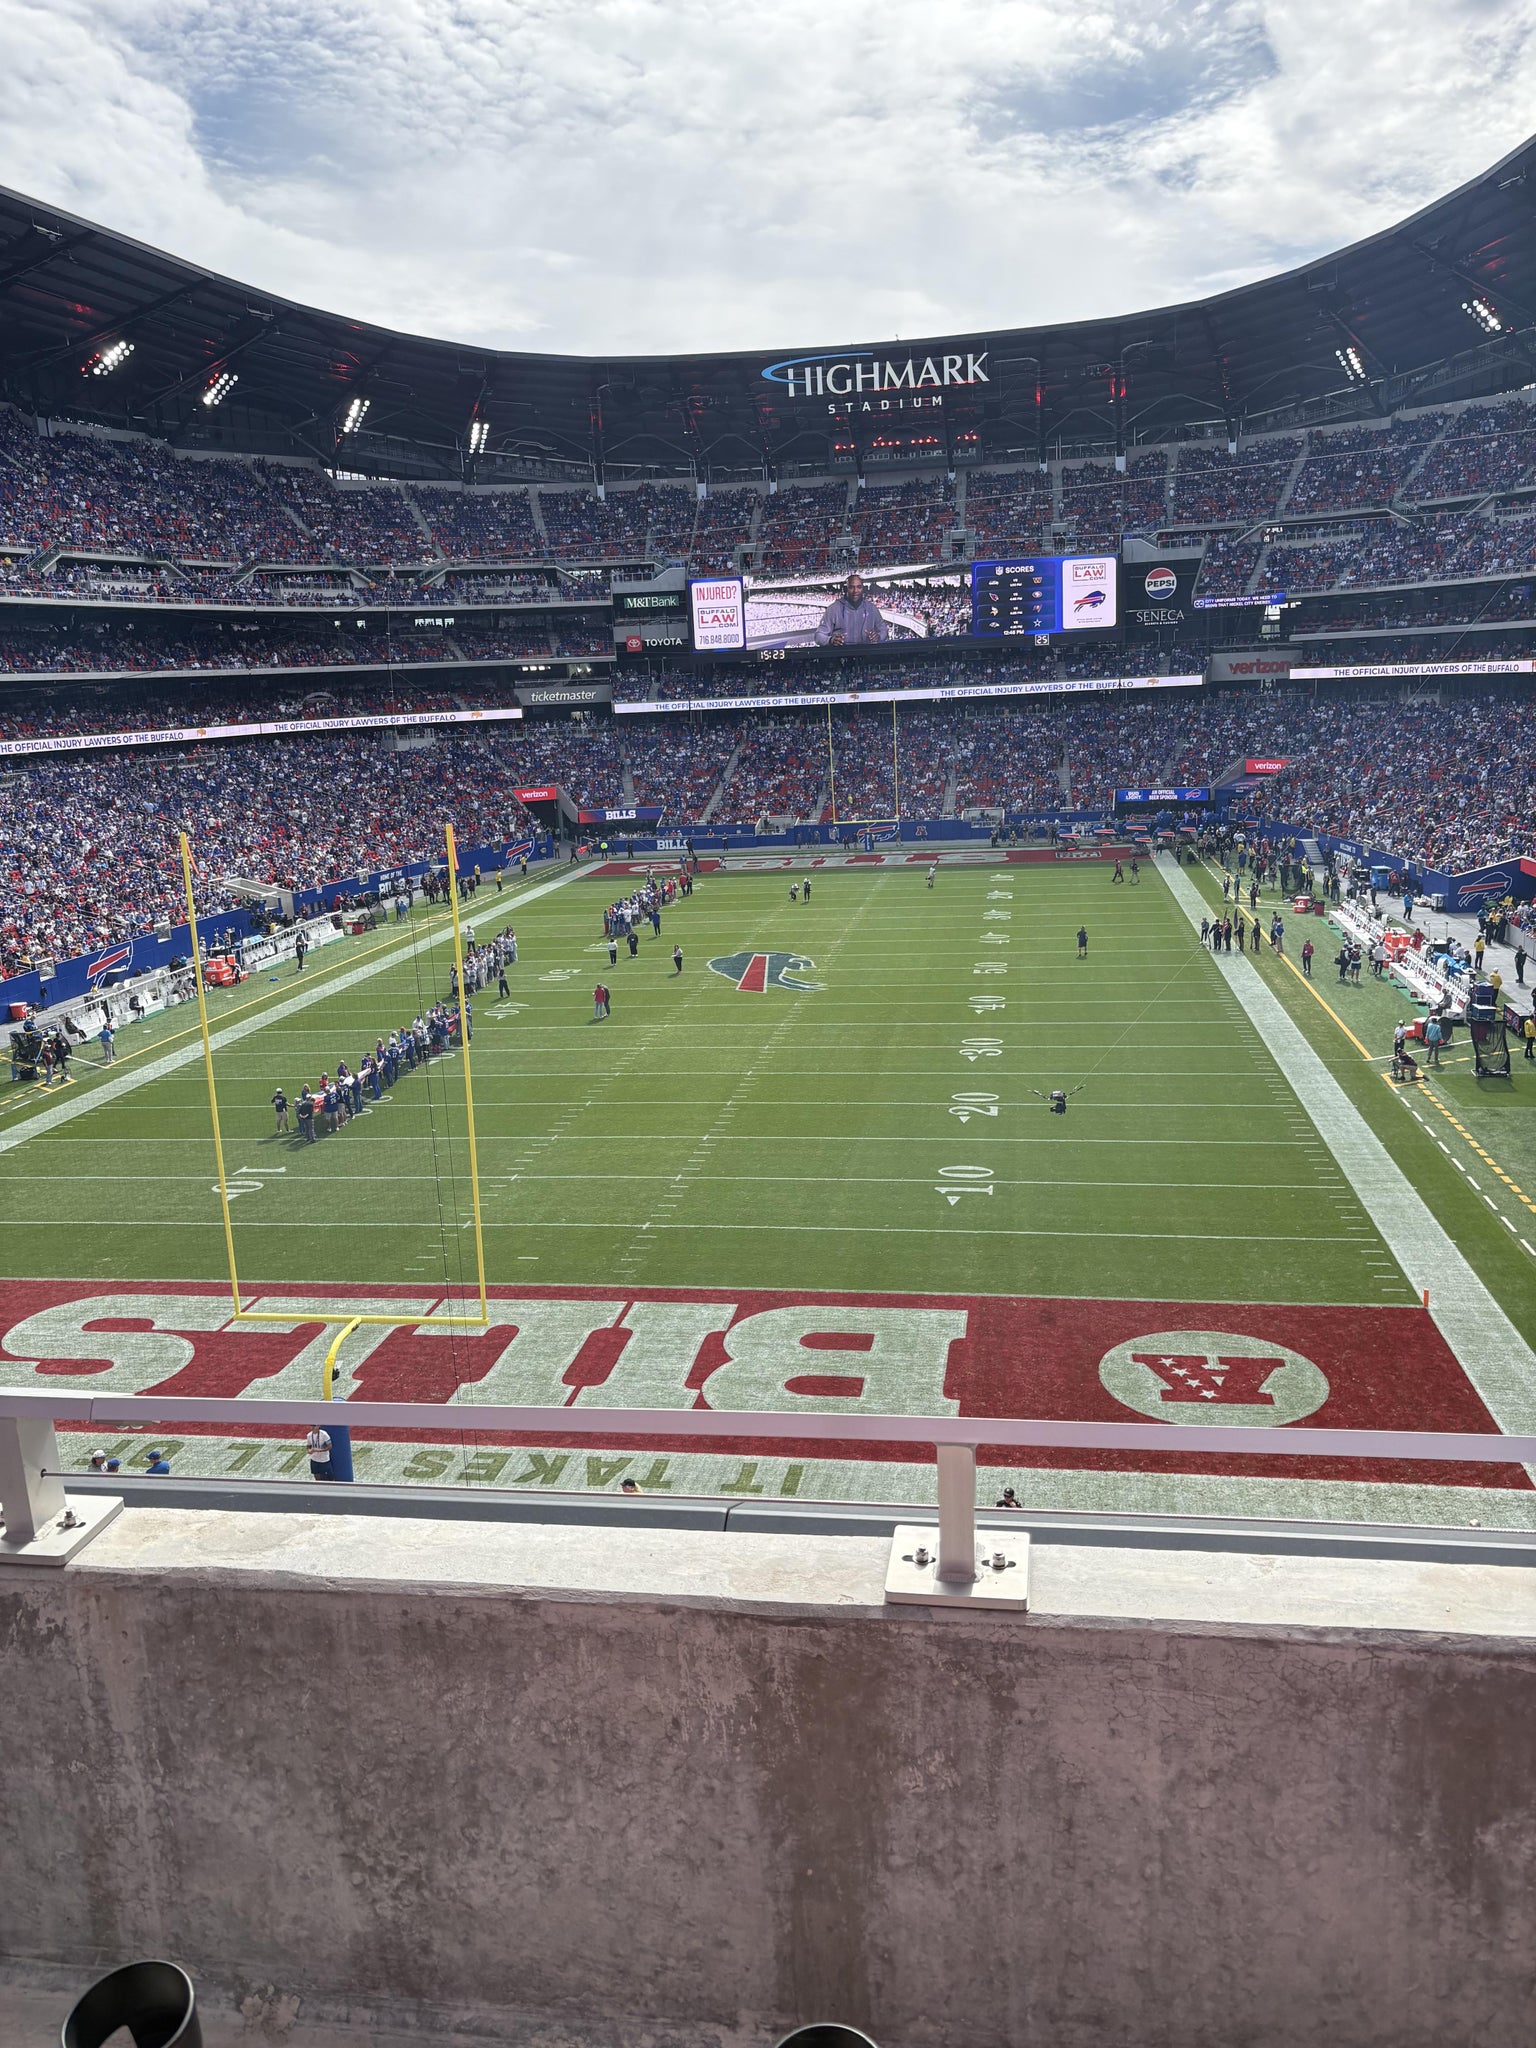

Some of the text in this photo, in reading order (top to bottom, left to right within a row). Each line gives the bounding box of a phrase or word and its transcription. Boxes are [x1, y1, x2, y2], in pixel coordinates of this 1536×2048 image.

[787, 352, 990, 397] HIGHMARK
[828, 396, 942, 414] STADIUM
[1005, 566, 1034, 574] SCORES
[1075, 570, 1104, 578] LAW
[1147, 579, 1175, 588] PEPSI
[696, 586, 737, 601] INJURED?
[626, 595, 677, 608] M&T Bank
[700, 614, 735, 624] LAW
[1136, 609, 1185, 623] SENECA
[645, 637, 682, 647] TOYOTA
[1036, 636, 1048, 644] 25
[761, 650, 785, 660] 15:23
[1228, 658, 1291, 675] verizon
[1352, 667, 1390, 676] OFFICIAL
[1392, 666, 1420, 675] INJURY
[1421, 665, 1460, 673] LAWYERS
[1488, 664, 1519, 672] BUFFALO
[957, 687, 993, 696] OFFICIAL
[994, 686, 1024, 694] INJURY
[1025, 684, 1064, 692] LAWYERS
[1096, 681, 1134, 690] BUFFALO
[531, 690, 596, 702] ticketmaster
[671, 702, 705, 710] OFFICIAL
[734, 699, 771, 707] LAWYERS
[800, 696, 836, 704] BUFFALO
[289, 722, 321, 730] OFFICIAL
[323, 720, 350, 728] INJURY
[351, 717, 389, 726] LAWYERS
[390, 716, 401, 725] OF
[419, 714, 456, 722] BUFFALO
[0, 732, 184, 753] HE OFFICIAL INJURY LAWYERS OF THE BUFFALO
[1255, 762, 1281, 770] verizon
[521, 790, 549, 799] verizon
[605, 810, 637, 820] BILLS
[656, 839, 689, 850] BILLS
[725, 851, 1010, 871] BILLS
[973, 962, 1008, 974] 50
[967, 996, 1006, 1010] 40
[959, 1038, 1003, 1057] 30
[949, 1092, 999, 1117] 20
[934, 1165, 994, 1196] 10
[1, 1294, 968, 1417] BILLS
[227, 1442, 371, 1475] LL
[403, 1450, 671, 1489] TAKES
[719, 1462, 803, 1495] IT
